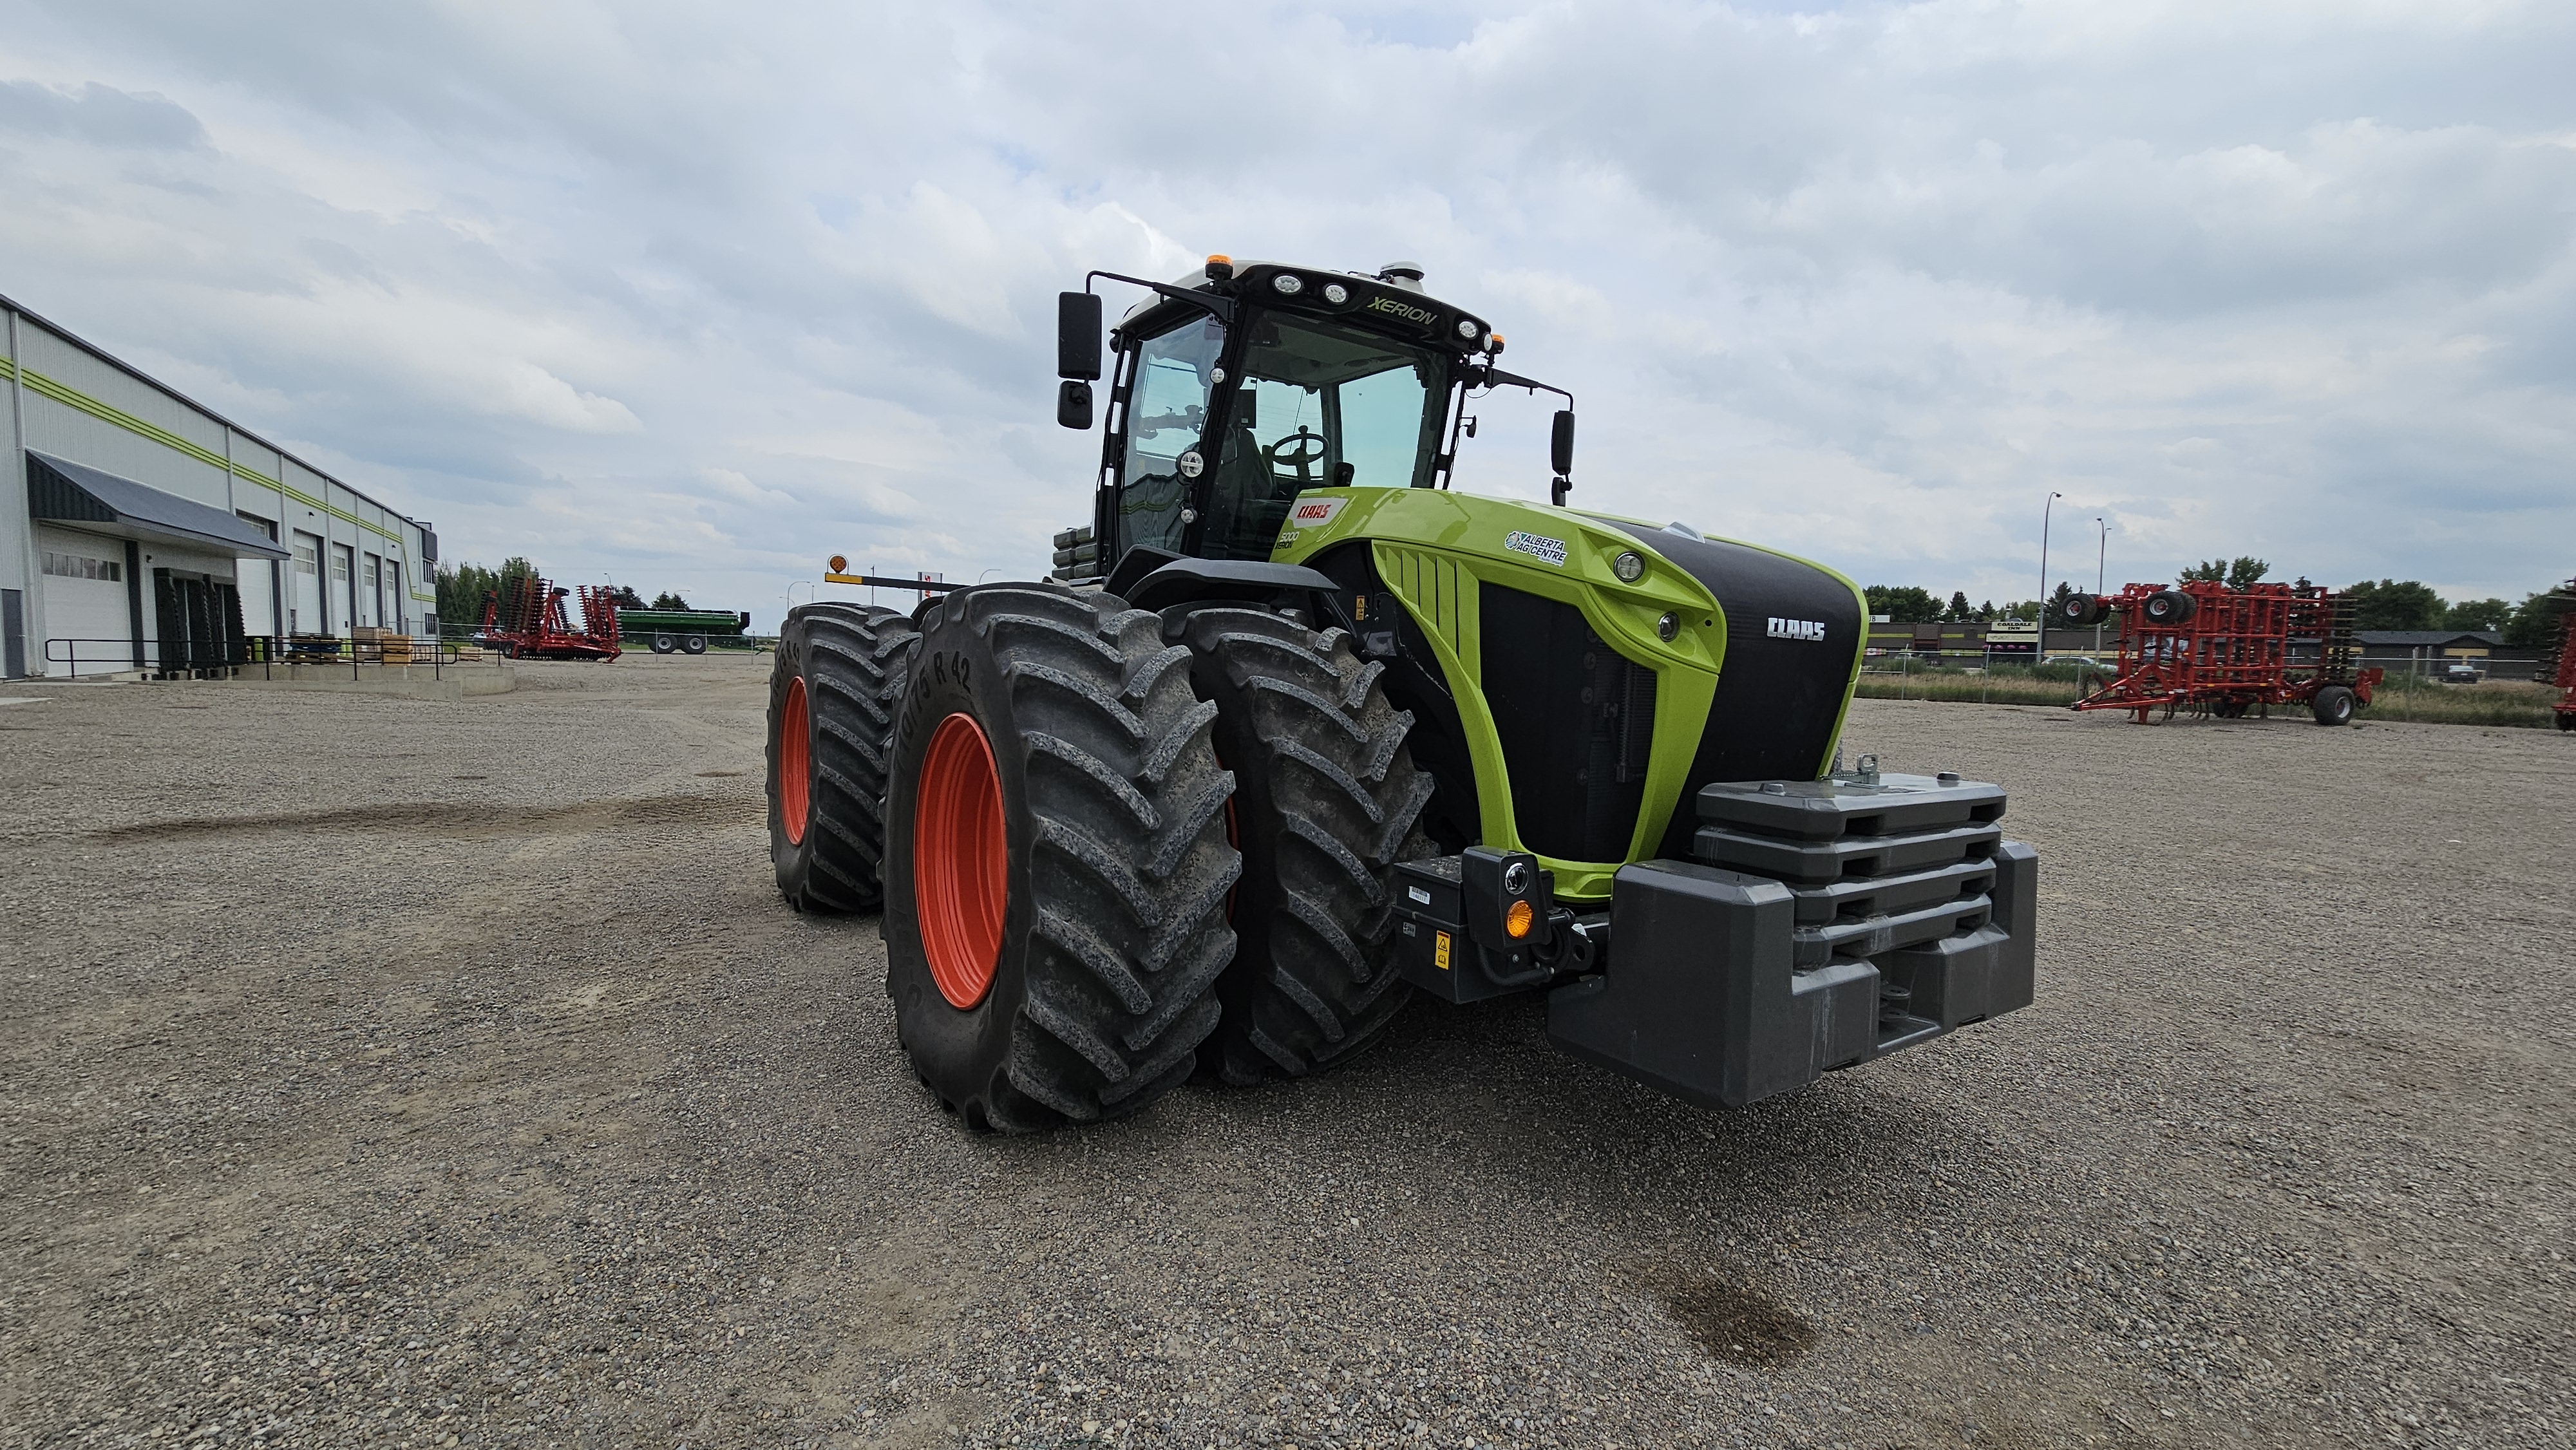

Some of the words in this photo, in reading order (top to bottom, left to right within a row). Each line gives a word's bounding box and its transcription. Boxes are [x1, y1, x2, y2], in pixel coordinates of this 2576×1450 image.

[1367, 296, 1437, 325] XERION
[1296, 504, 1331, 519] CLAAS
[1279, 531, 1300, 542] 5000
[1522, 534, 1564, 551] ALBERTA
[1274, 541, 1293, 550] XERION
[1516, 543, 1530, 552] AG
[1530, 546, 1566, 561] CENTRE
[1767, 617, 1824, 641] CLAAS
[934, 651, 947, 684] R
[951, 650, 971, 696] 42
